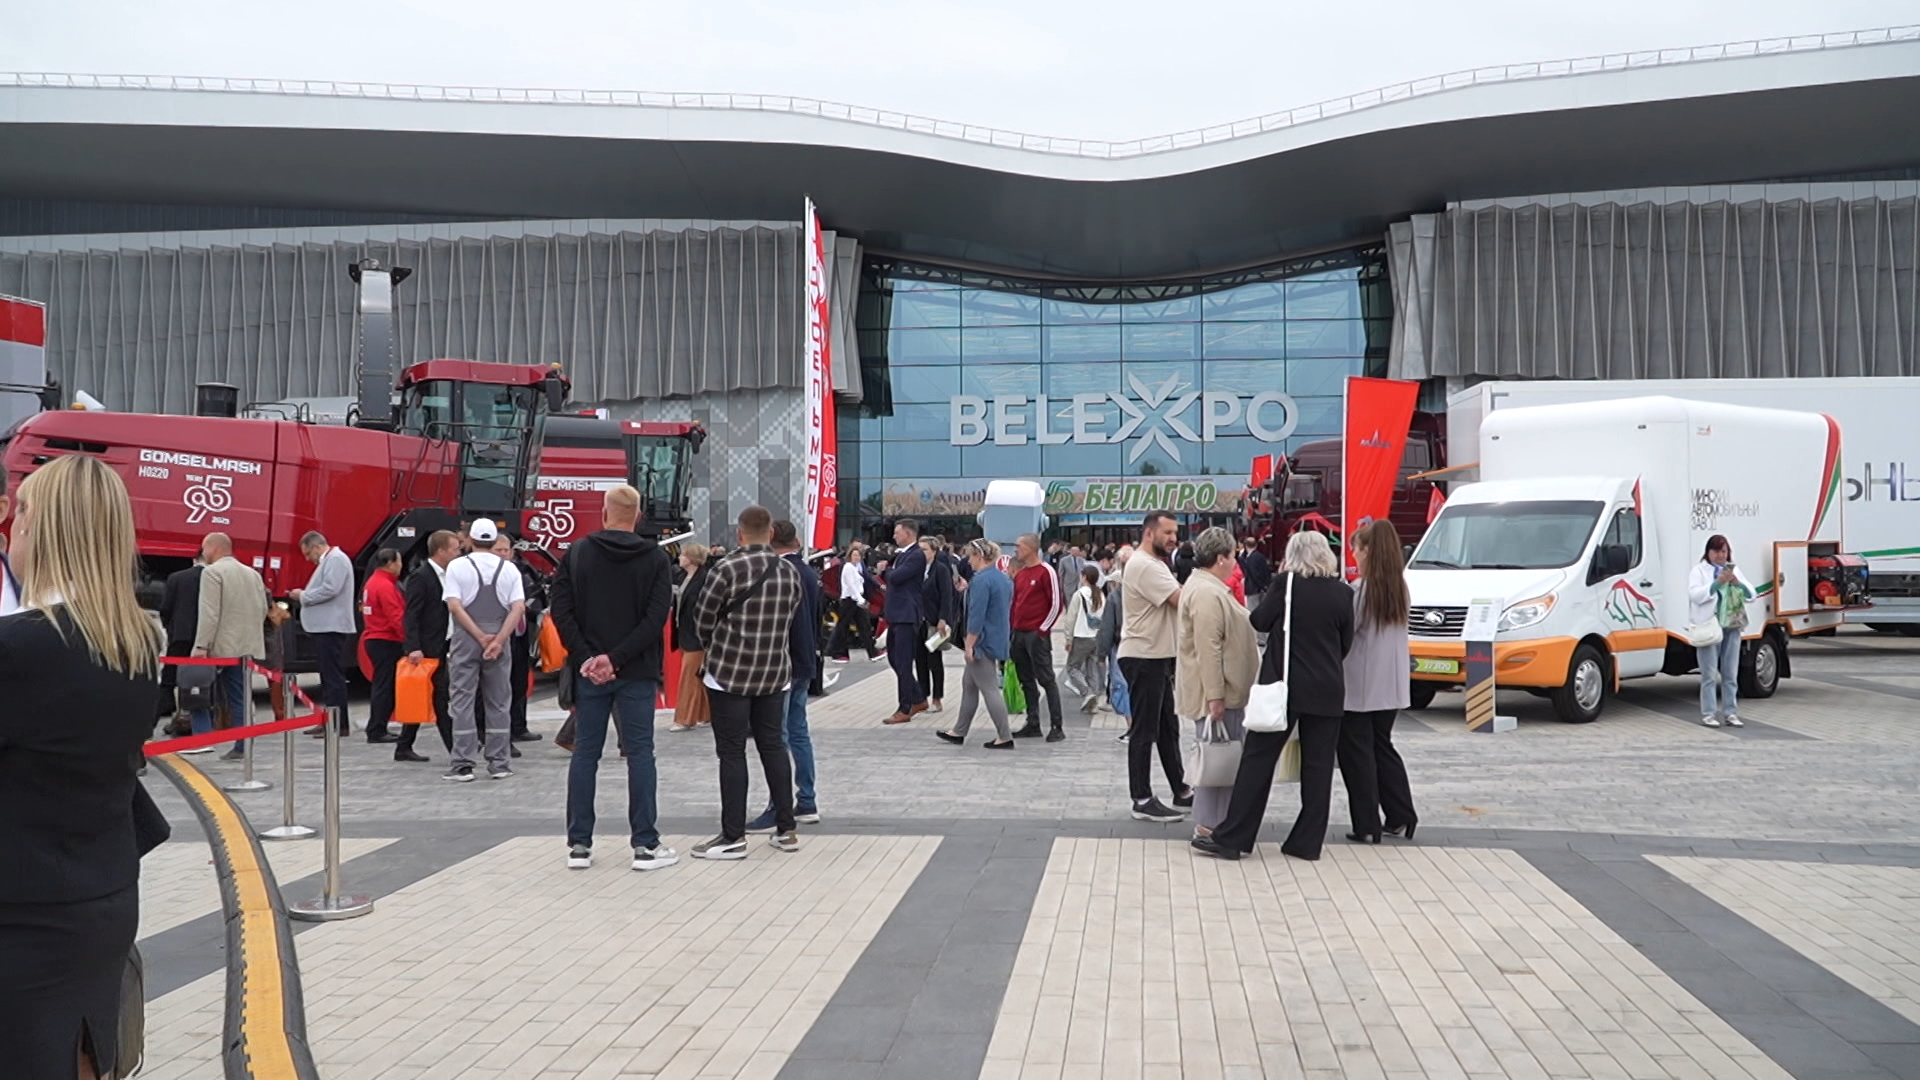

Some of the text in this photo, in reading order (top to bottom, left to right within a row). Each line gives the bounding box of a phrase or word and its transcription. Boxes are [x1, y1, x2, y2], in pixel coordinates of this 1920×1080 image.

[950, 370, 1299, 465] BELEXPO
[140, 448, 261, 475] GOMSELMASH
[183, 474, 233, 524] 95
[537, 479, 594, 491] ELMASH
[1083, 481, 1218, 512] БЕЛАГРО
